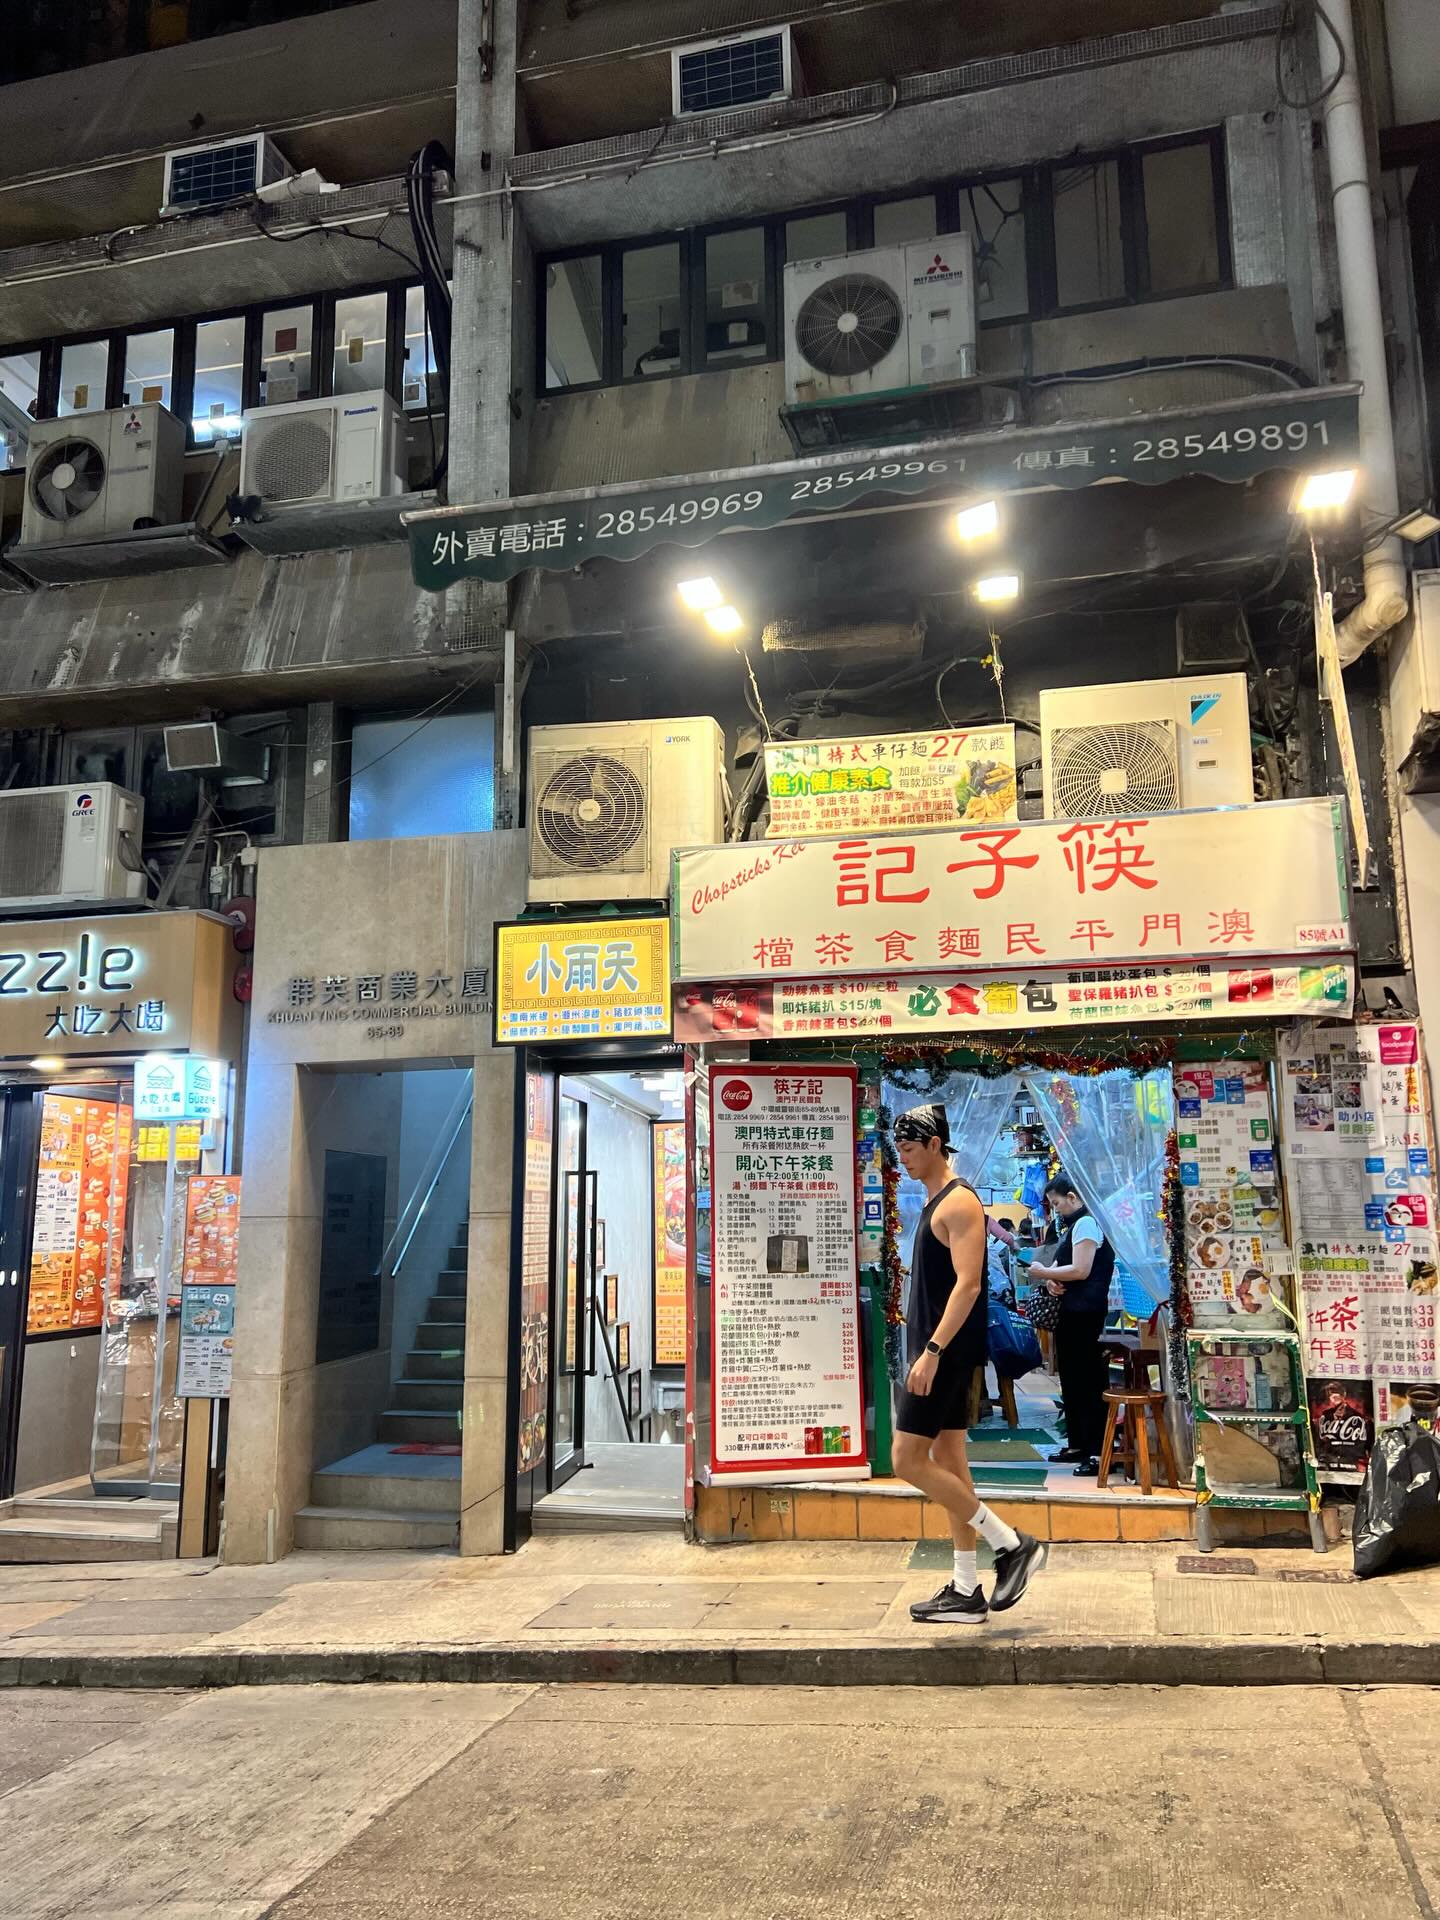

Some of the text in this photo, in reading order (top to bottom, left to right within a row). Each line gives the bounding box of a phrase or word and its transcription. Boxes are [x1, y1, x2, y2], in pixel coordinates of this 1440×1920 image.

[595, 491, 764, 538] 28549969
[791, 457, 968, 500] 28549961
[1132, 420, 1331, 463] 28549891
[691, 857, 772, 915] Chopsticks
[525, 942, 640, 996] 小雨天
[1067, 967, 1156, 984] 葡國腸炒蛋包
[288, 966, 490, 1006] 群英商業大廈
[782, 983, 835, 997] 勁辣魚蛋
[1068, 984, 1159, 1002] 聖保羅豬扒包
[782, 997, 882, 1015] 即炸豬扒 $15/塊
[906, 980, 1058, 1019] 必食葡包
[44, 1000, 165, 1038] 大吃大喝
[318, 1007, 349, 1023] YING
[351, 1003, 440, 1021] COMMERCIAL
[444, 1000, 494, 1016] BUILDIN
[773, 1078, 824, 1095] 筷子記
[1338, 1111, 1375, 1123] 助小店
[734, 1126, 834, 1141] 澳門特式車仔麵
[742, 1141, 826, 1150] 所有茶餐附送熱飲一杯
[735, 1155, 834, 1172] 開心下午茶餐
[744, 1171, 826, 1181] (由下午2:00至11:00)
[769, 1182, 804, 1191] 下午茶餐
[842, 1307, 853, 1315] $22
[842, 1330, 855, 1338] $26
[842, 1338, 855, 1346] $26
[842, 1346, 855, 1354] $26
[842, 1354, 855, 1362] $26
[1310, 1338, 1358, 1361] 午餐
[738, 1432, 788, 1442] 配可口可樂公司
